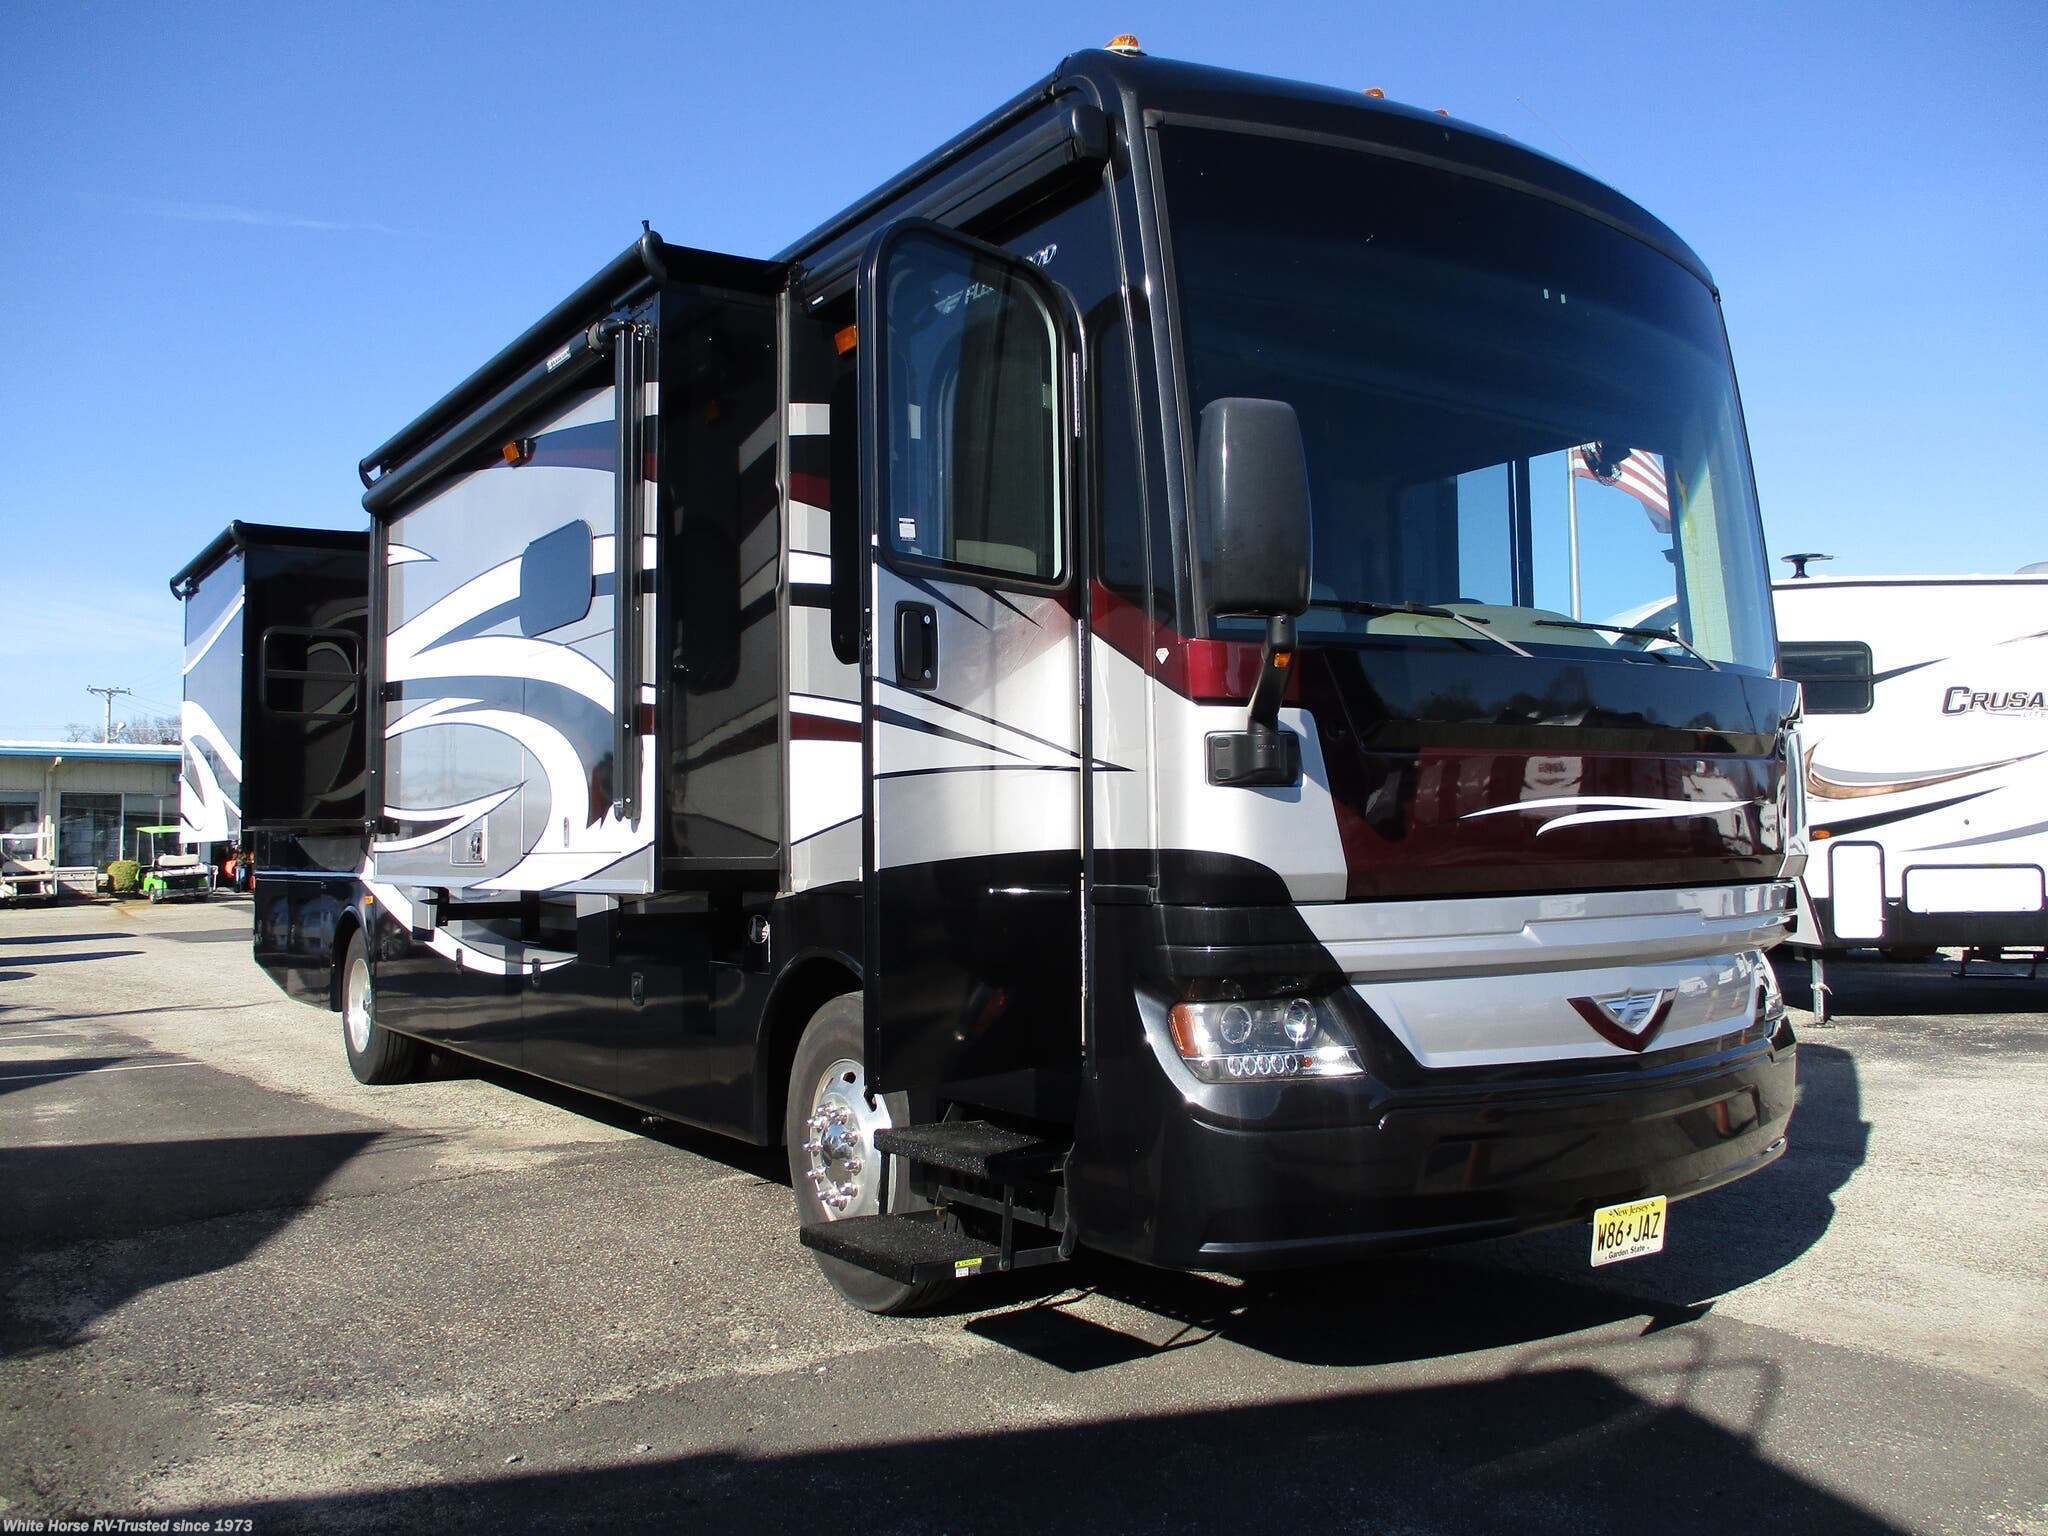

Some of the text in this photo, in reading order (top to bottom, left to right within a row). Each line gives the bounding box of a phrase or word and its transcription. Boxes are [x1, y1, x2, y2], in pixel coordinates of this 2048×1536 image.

[1612, 1205, 1648, 1217] New Jersey
[1608, 1245, 1645, 1259] Garden State
